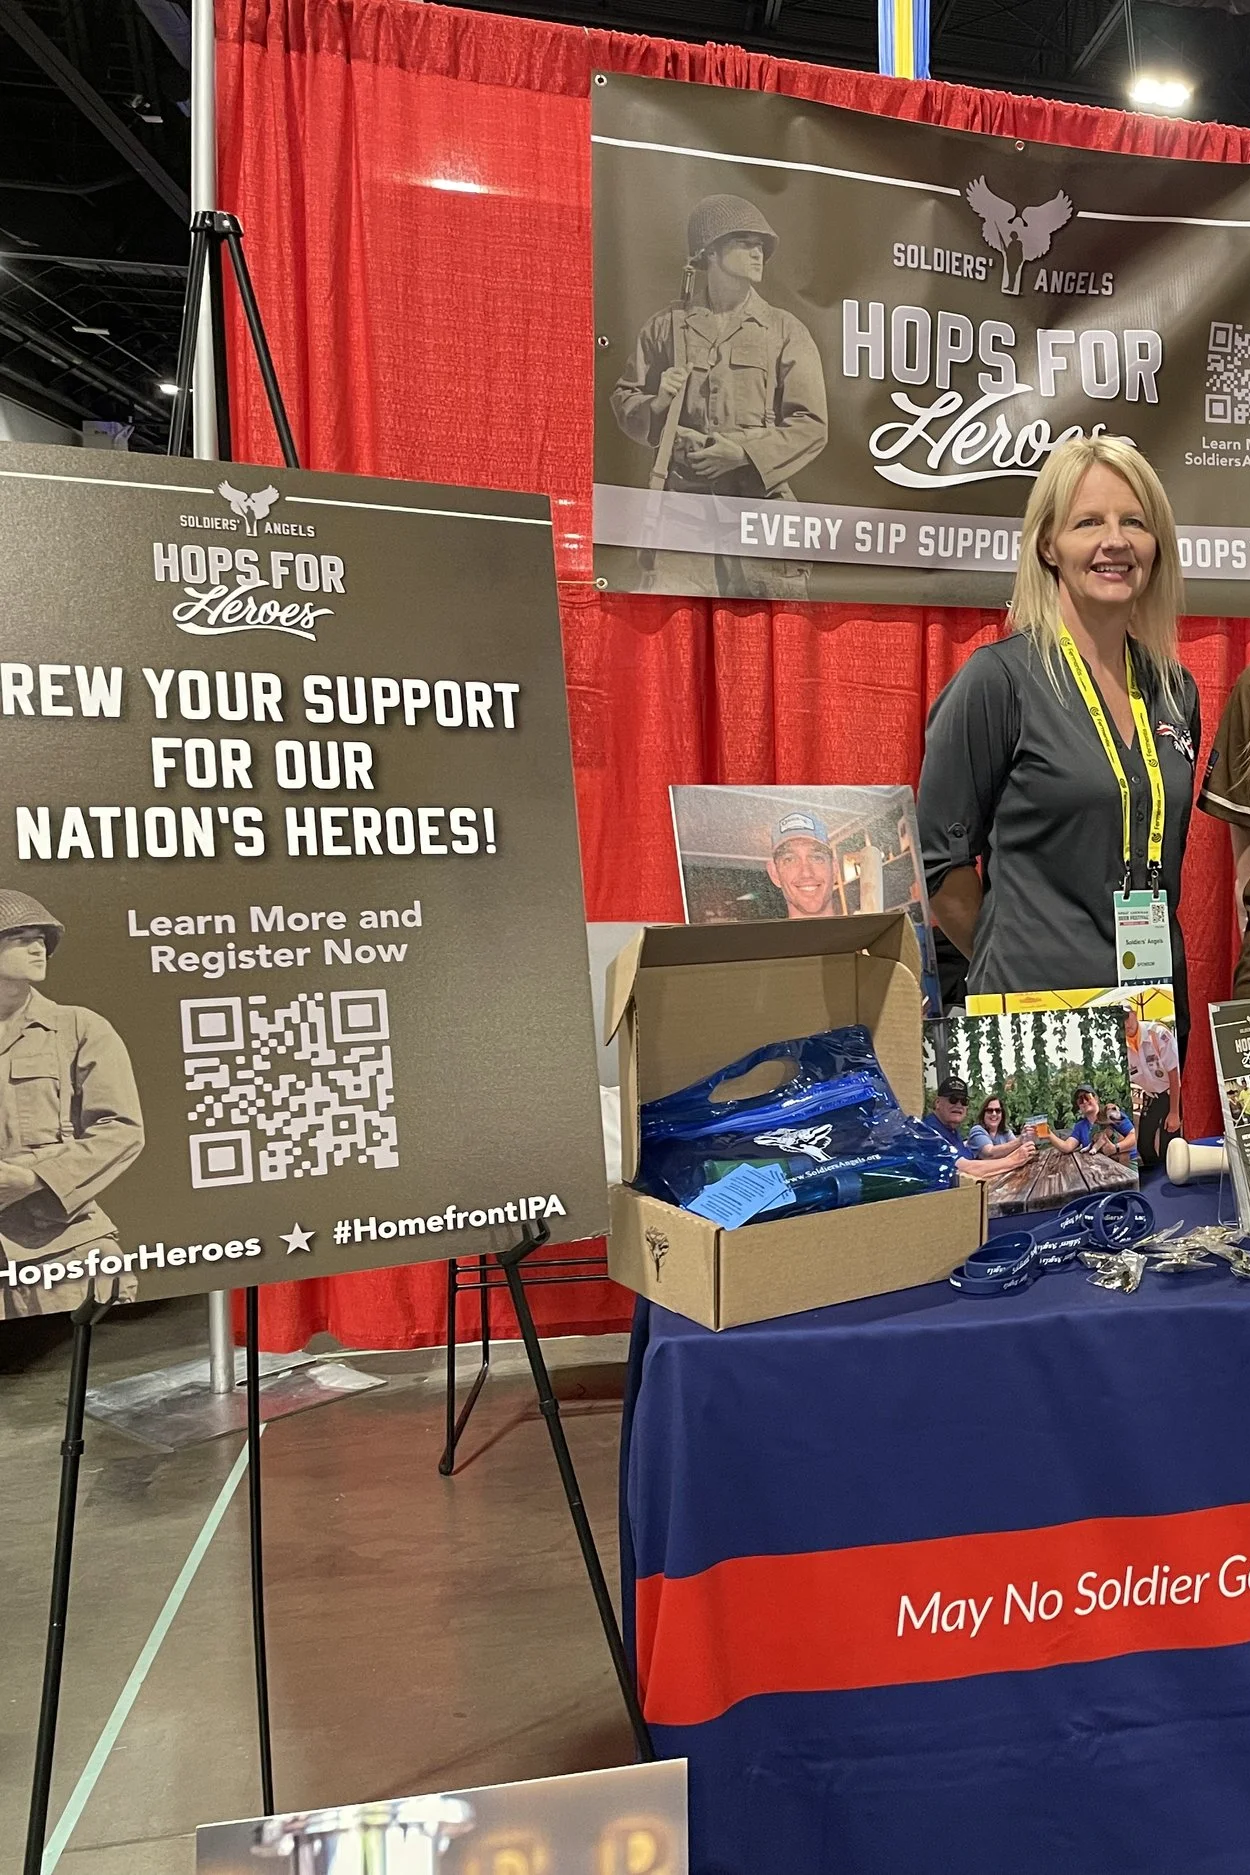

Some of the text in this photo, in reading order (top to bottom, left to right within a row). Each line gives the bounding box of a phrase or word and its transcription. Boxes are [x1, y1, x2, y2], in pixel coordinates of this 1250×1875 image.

[893, 242, 1114, 296] SOLDIERS' ANGELS
[842, 299, 1163, 404] HOPS FOR
[1201, 437, 1241, 453] Learn
[179, 514, 315, 537] SOLDIERS' ANGELS
[740, 511, 843, 550] EVERY
[855, 521, 906, 554] SIP
[153, 542, 346, 594] HOPS FOR
[172, 579, 335, 641] Heroes
[142, 668, 284, 723] YOUR
[303, 675, 520, 730] SUPPORT
[151, 737, 375, 790] FOR OUR
[16, 805, 498, 860] NATION'S HEROES!
[127, 900, 423, 938] Learn More and
[150, 939, 408, 980] Register Now
[784, 1153, 882, 1185] www.SoldiersAngels.org
[332, 1193, 566, 1246] #HomefrontIPA
[896, 1591, 992, 1639] May
[1002, 1583, 1065, 1628] No
[1074, 1568, 1213, 1617] Soldier
